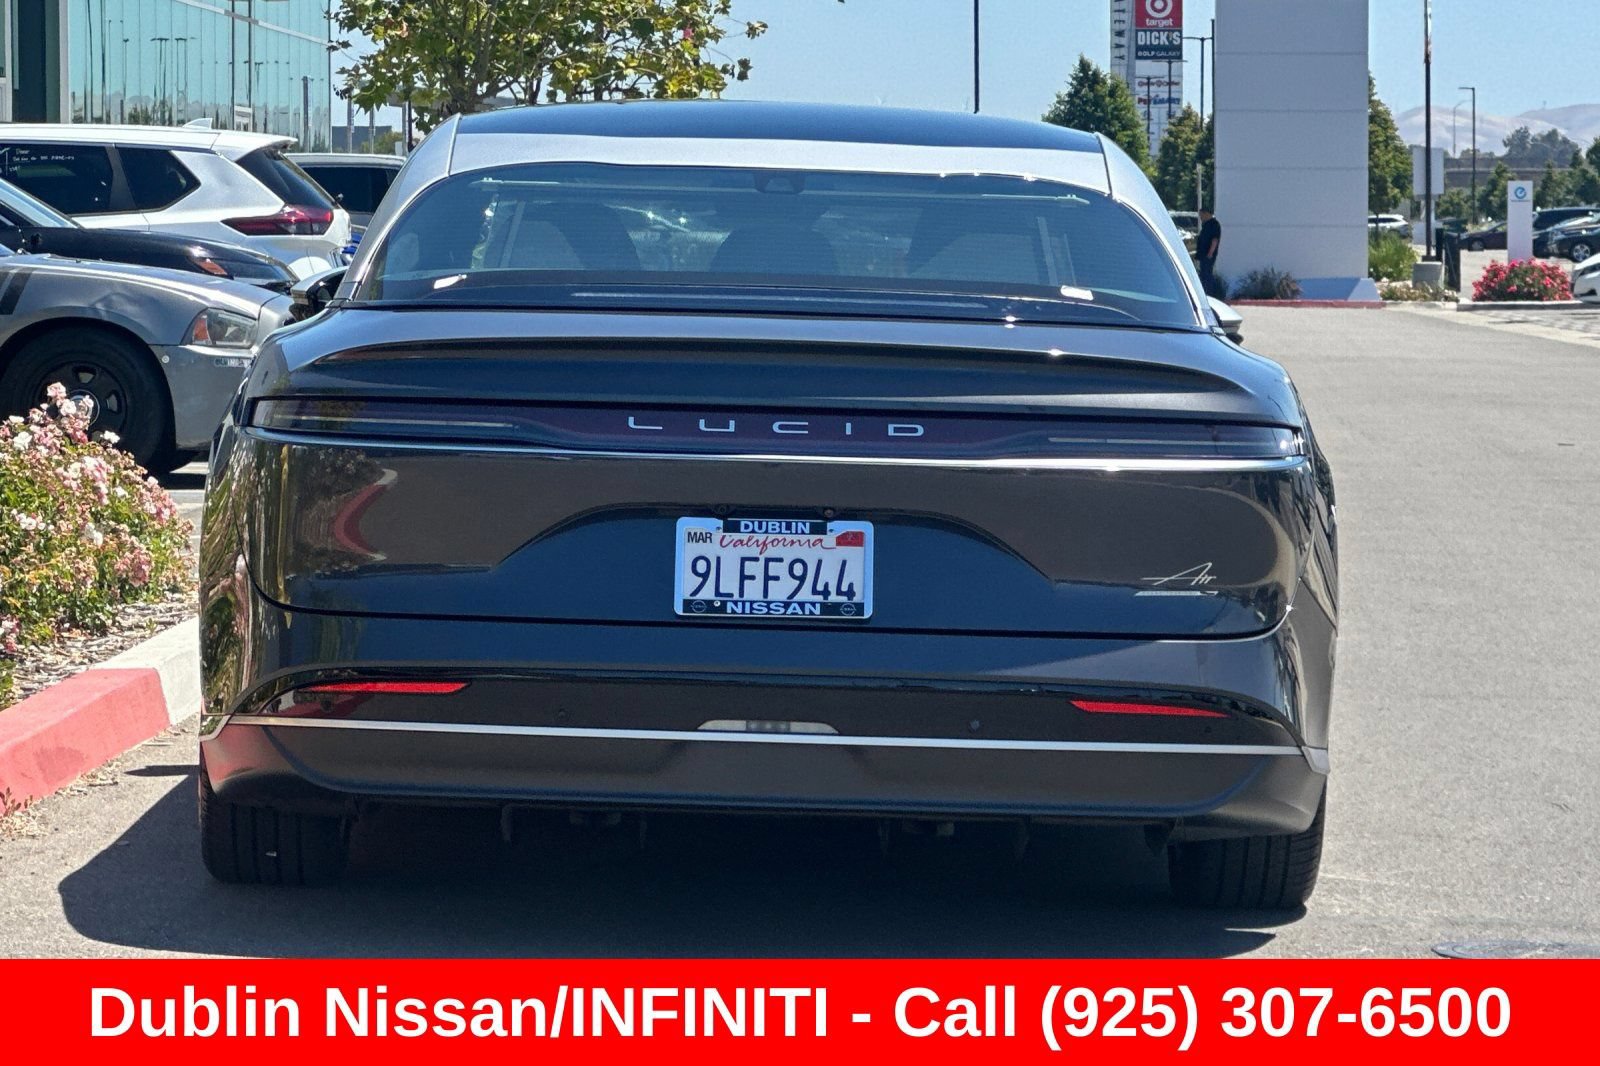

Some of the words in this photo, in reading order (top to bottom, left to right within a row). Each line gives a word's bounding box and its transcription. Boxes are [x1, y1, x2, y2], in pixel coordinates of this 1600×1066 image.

[1145, 18, 1174, 27] target
[1114, 0, 1126, 60] TEWAY
[1137, 31, 1181, 45] DICK'S
[627, 415, 925, 437] LUCID
[740, 520, 810, 534] DUBLIN
[687, 532, 713, 544] MAR
[719, 534, 836, 555] California
[689, 555, 856, 601] 9LFF944
[726, 601, 821, 615] NISSAN
